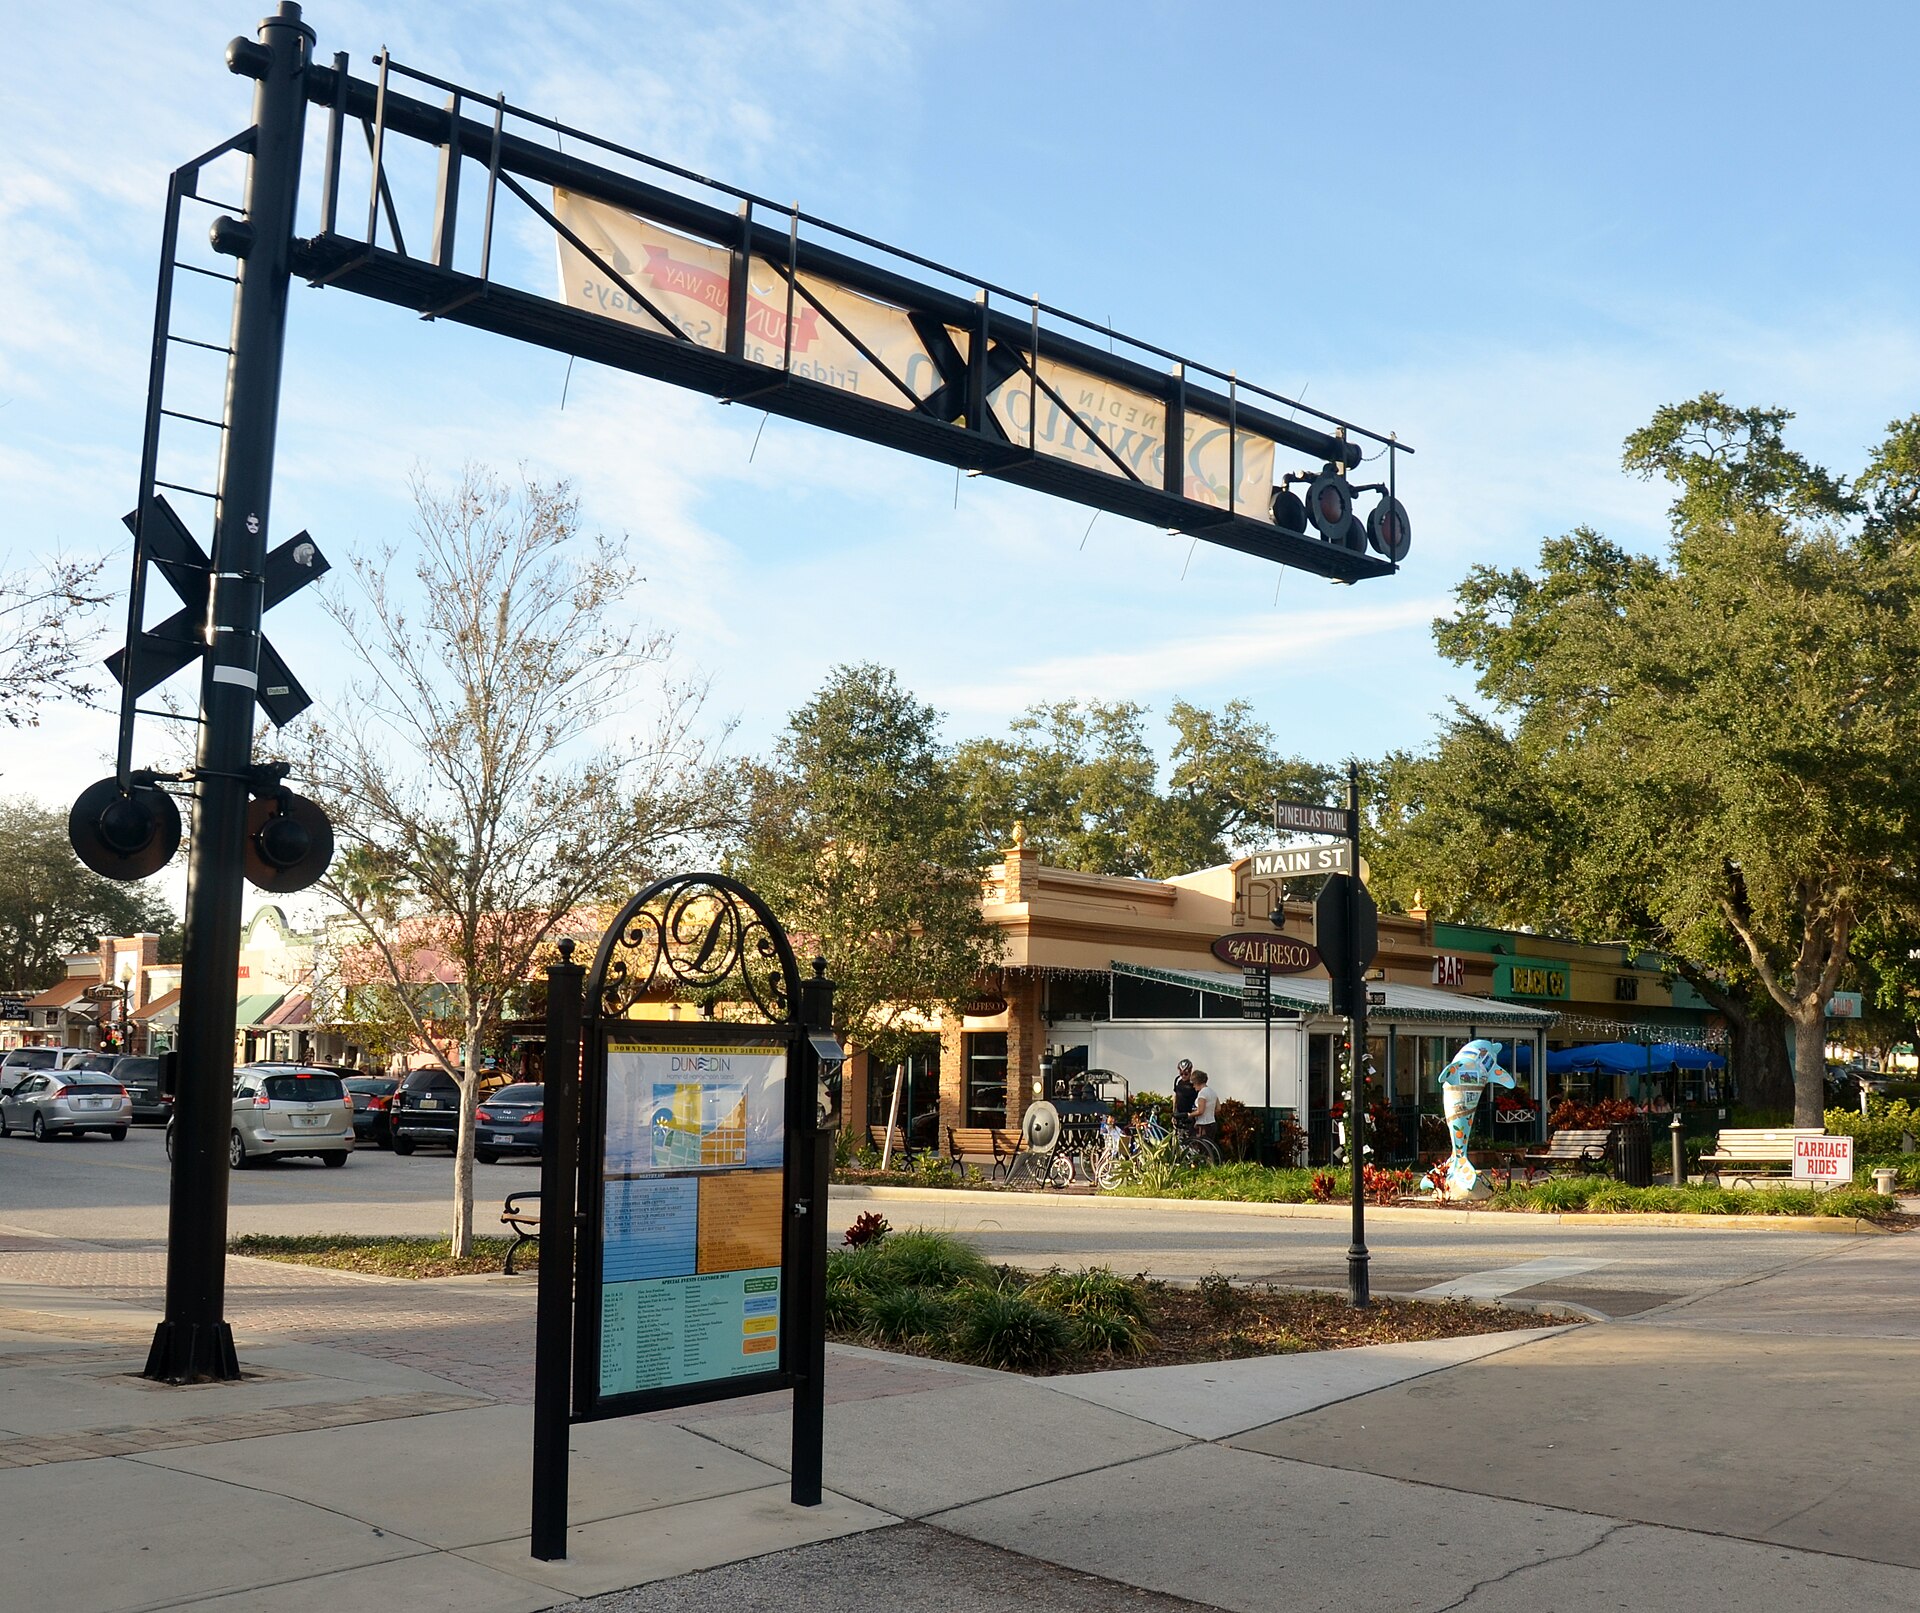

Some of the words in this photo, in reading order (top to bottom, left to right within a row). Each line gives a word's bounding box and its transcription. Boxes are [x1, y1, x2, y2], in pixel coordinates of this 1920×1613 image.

[1278, 805, 1320, 828] PINELLAS
[1322, 811, 1346, 831] TRAIL
[1255, 851, 1310, 875] MAIN
[1318, 848, 1345, 868] ST
[1245, 941, 1310, 967] ALFRESCO
[1434, 956, 1465, 986] BAR
[1514, 967, 1546, 994] BEACH
[1550, 971, 1565, 996] CO
[671, 1056, 731, 1072] DUNEDIN
[1797, 1141, 1848, 1158] CARRIAGE
[1807, 1159, 1837, 1175] RIDES
